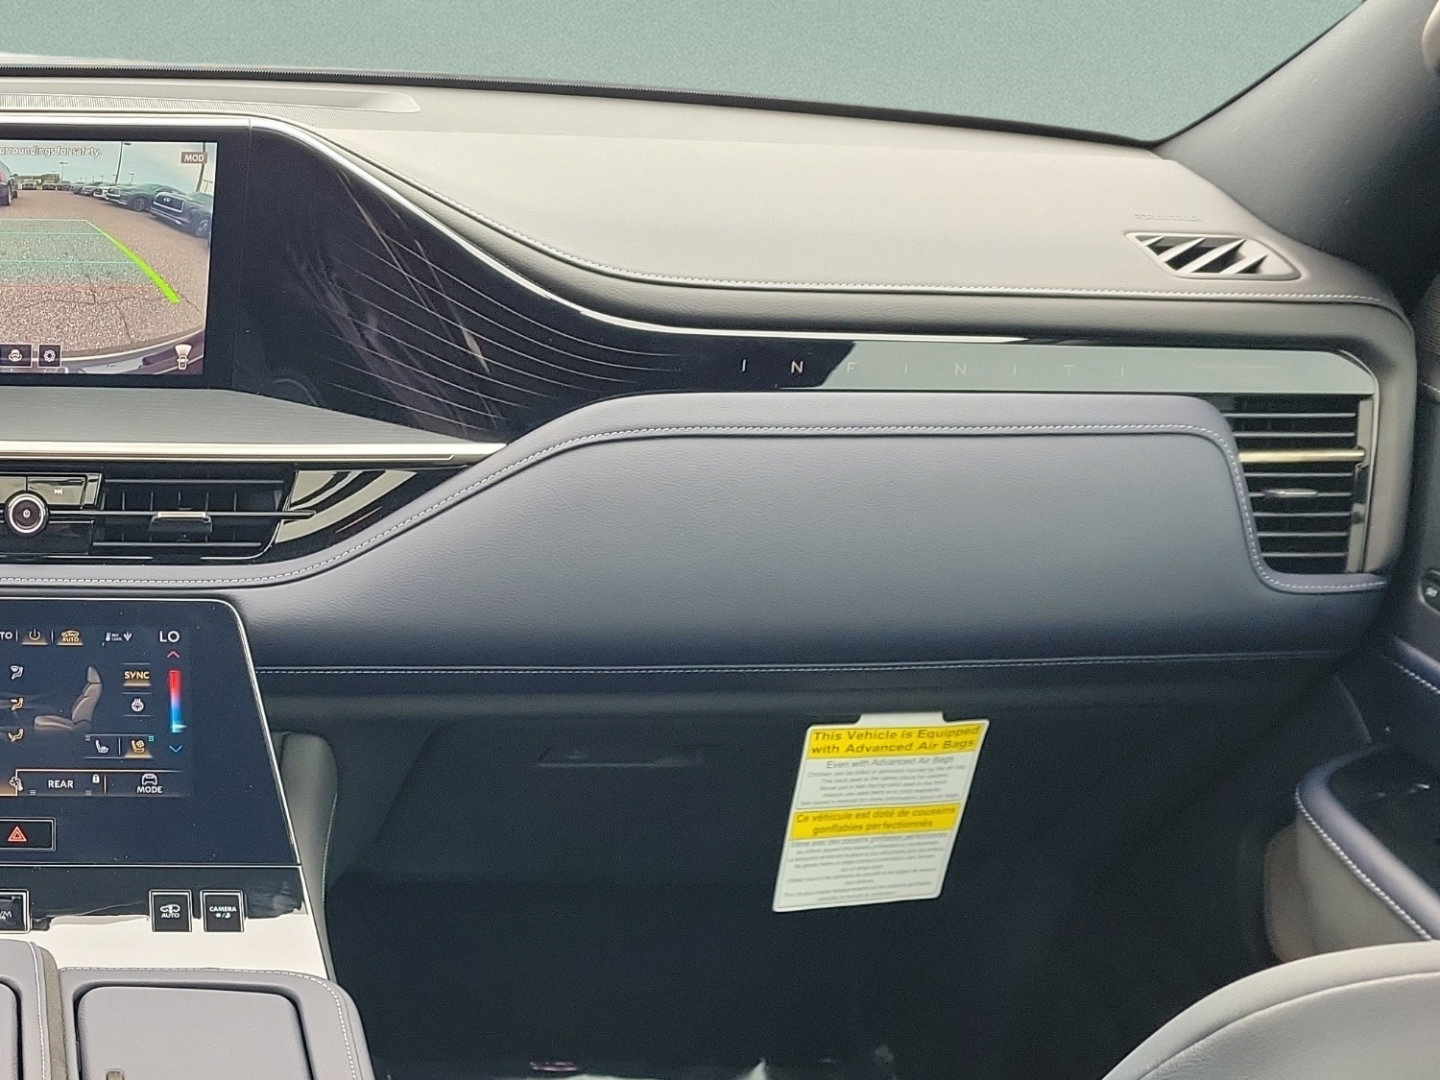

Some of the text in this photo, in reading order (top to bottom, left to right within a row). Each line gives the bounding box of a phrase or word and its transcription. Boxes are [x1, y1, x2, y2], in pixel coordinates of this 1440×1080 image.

[57, 147, 71, 155] for
[184, 154, 205, 163] MOD
[159, 630, 181, 643] LO
[124, 671, 150, 680] SYNC
[813, 726, 980, 741] This Vehicle is Equipped
[811, 739, 975, 754] with Advanced Air Bags
[826, 761, 848, 769] Even
[47, 780, 74, 789] REAR
[136, 786, 163, 794] MODE
[796, 814, 810, 823] Ce
[855, 811, 871, 820] est
[898, 808, 910, 818] de
[912, 805, 956, 817] coussins
[812, 824, 863, 836] gonflables
